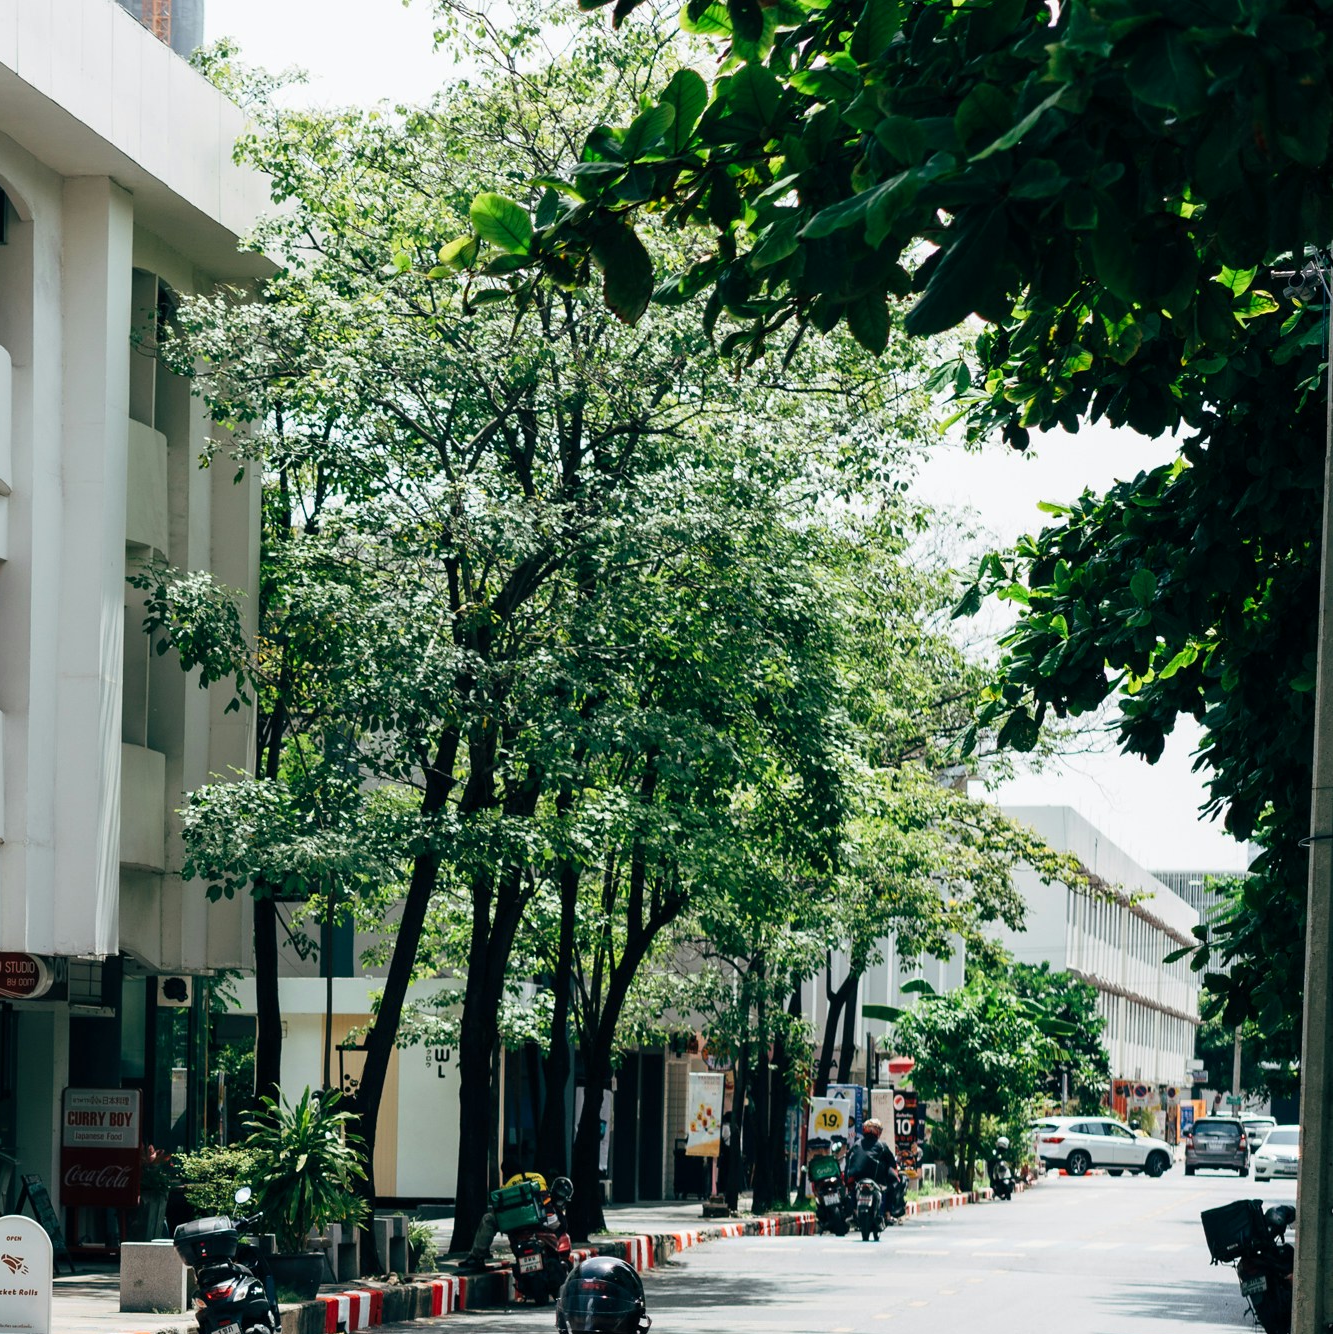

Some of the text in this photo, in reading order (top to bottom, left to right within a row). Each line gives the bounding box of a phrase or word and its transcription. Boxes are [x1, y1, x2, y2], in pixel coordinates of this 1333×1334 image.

[67, 1111, 133, 1127] CURRY BOY
[75, 1132, 123, 1141] Japanese Food
[18, 1288, 38, 1296] Rolls
